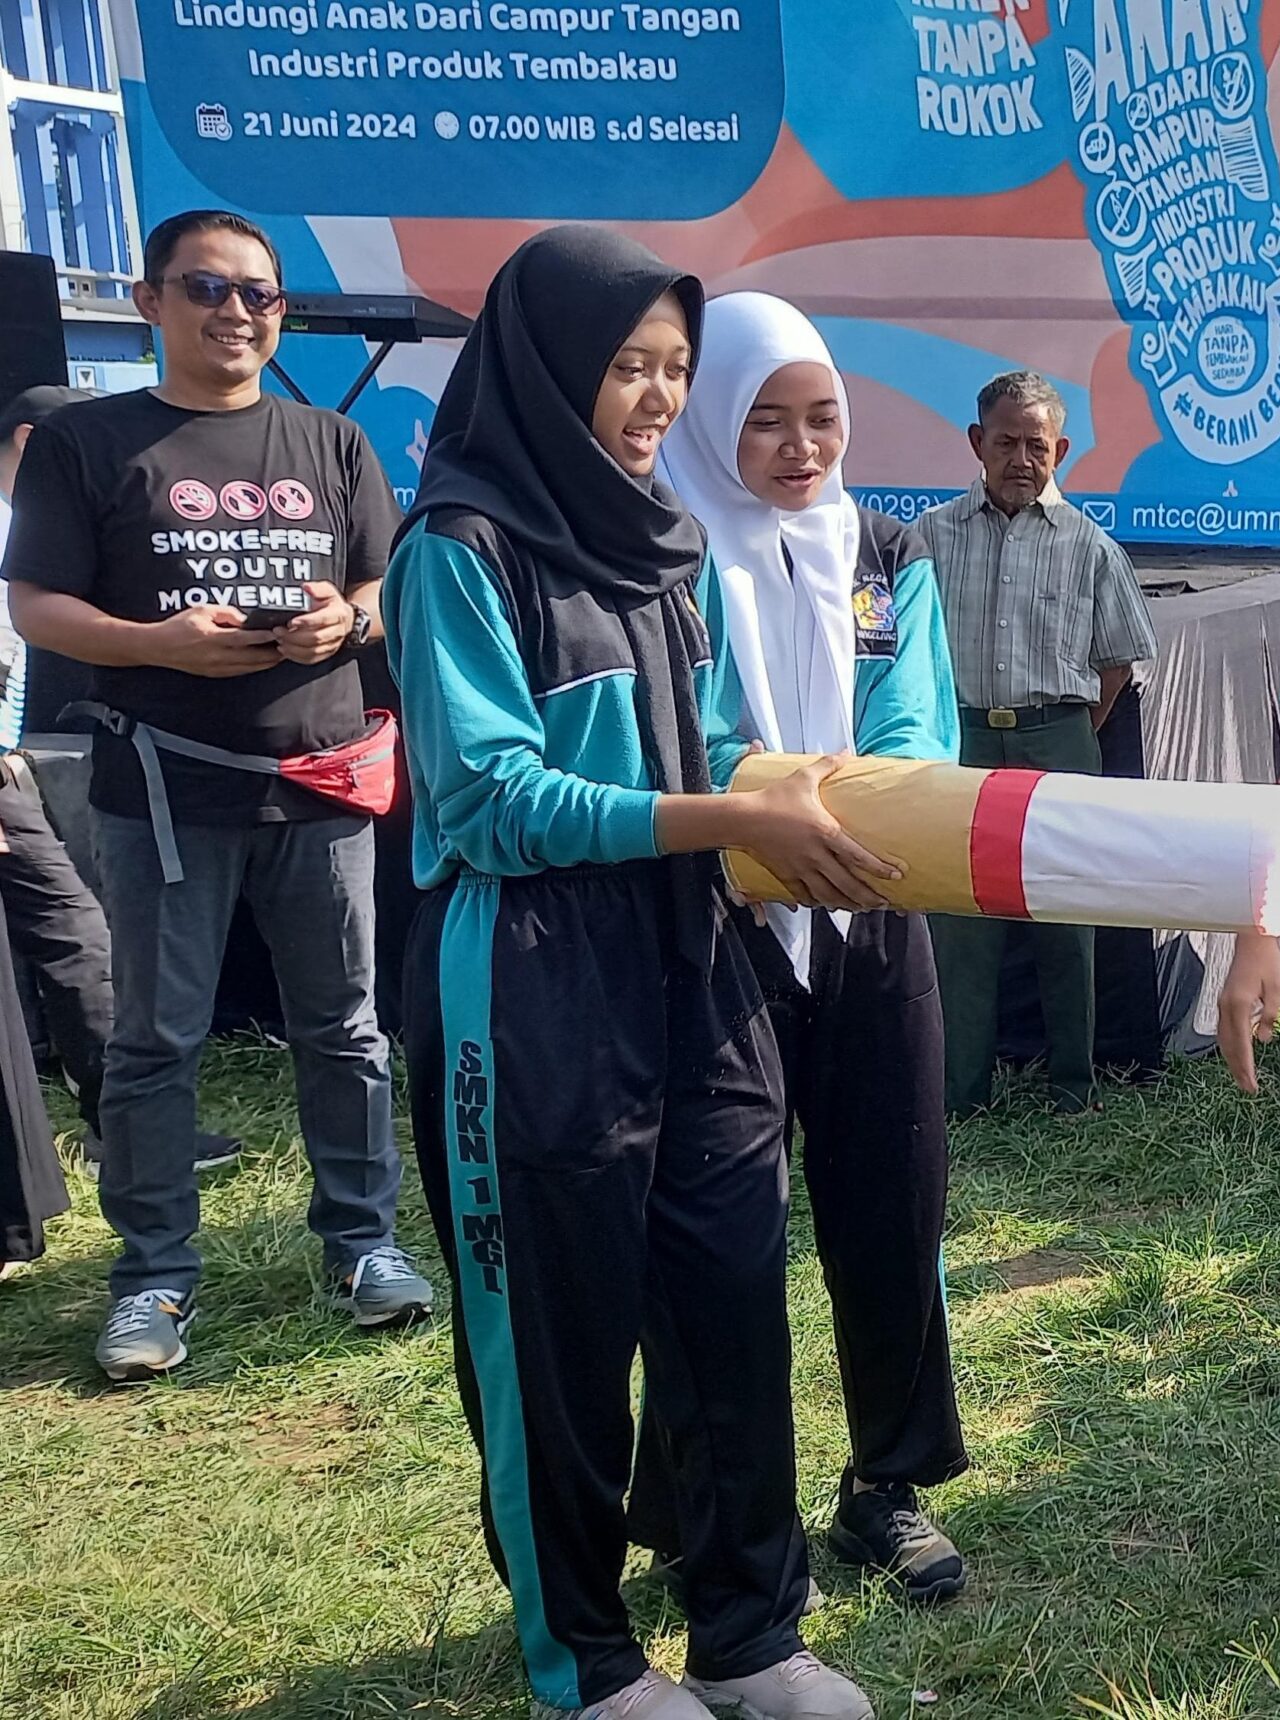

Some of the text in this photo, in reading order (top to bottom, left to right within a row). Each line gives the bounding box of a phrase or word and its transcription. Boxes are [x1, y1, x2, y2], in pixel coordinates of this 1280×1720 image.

[175, 0, 741, 37] Lindungi Anak Dari Campur Tangan
[912, 15, 1036, 77] TANPA
[248, 48, 678, 80] Industri Produk Tembakau
[1147, 63, 1209, 118] DARI
[243, 110, 416, 138] 21 Juni 2024
[469, 113, 739, 141] 07.00 WIB s.d Selesai
[916, 75, 1043, 136] ROKOK
[1118, 108, 1219, 182] CAMPUR
[1135, 150, 1225, 211] TANGAN
[1152, 184, 1235, 248] INDUSTRI
[1152, 220, 1257, 305] PRODUK
[1169, 272, 1266, 358] TEMBAKAU
[1204, 334, 1248, 353] TANPA
[151, 528, 334, 556] SMOKE-FREE
[186, 556, 311, 580] YOUTH
[157, 584, 310, 612] MOVEME
[453, 1040, 504, 1296] SMKN 1 MGL
